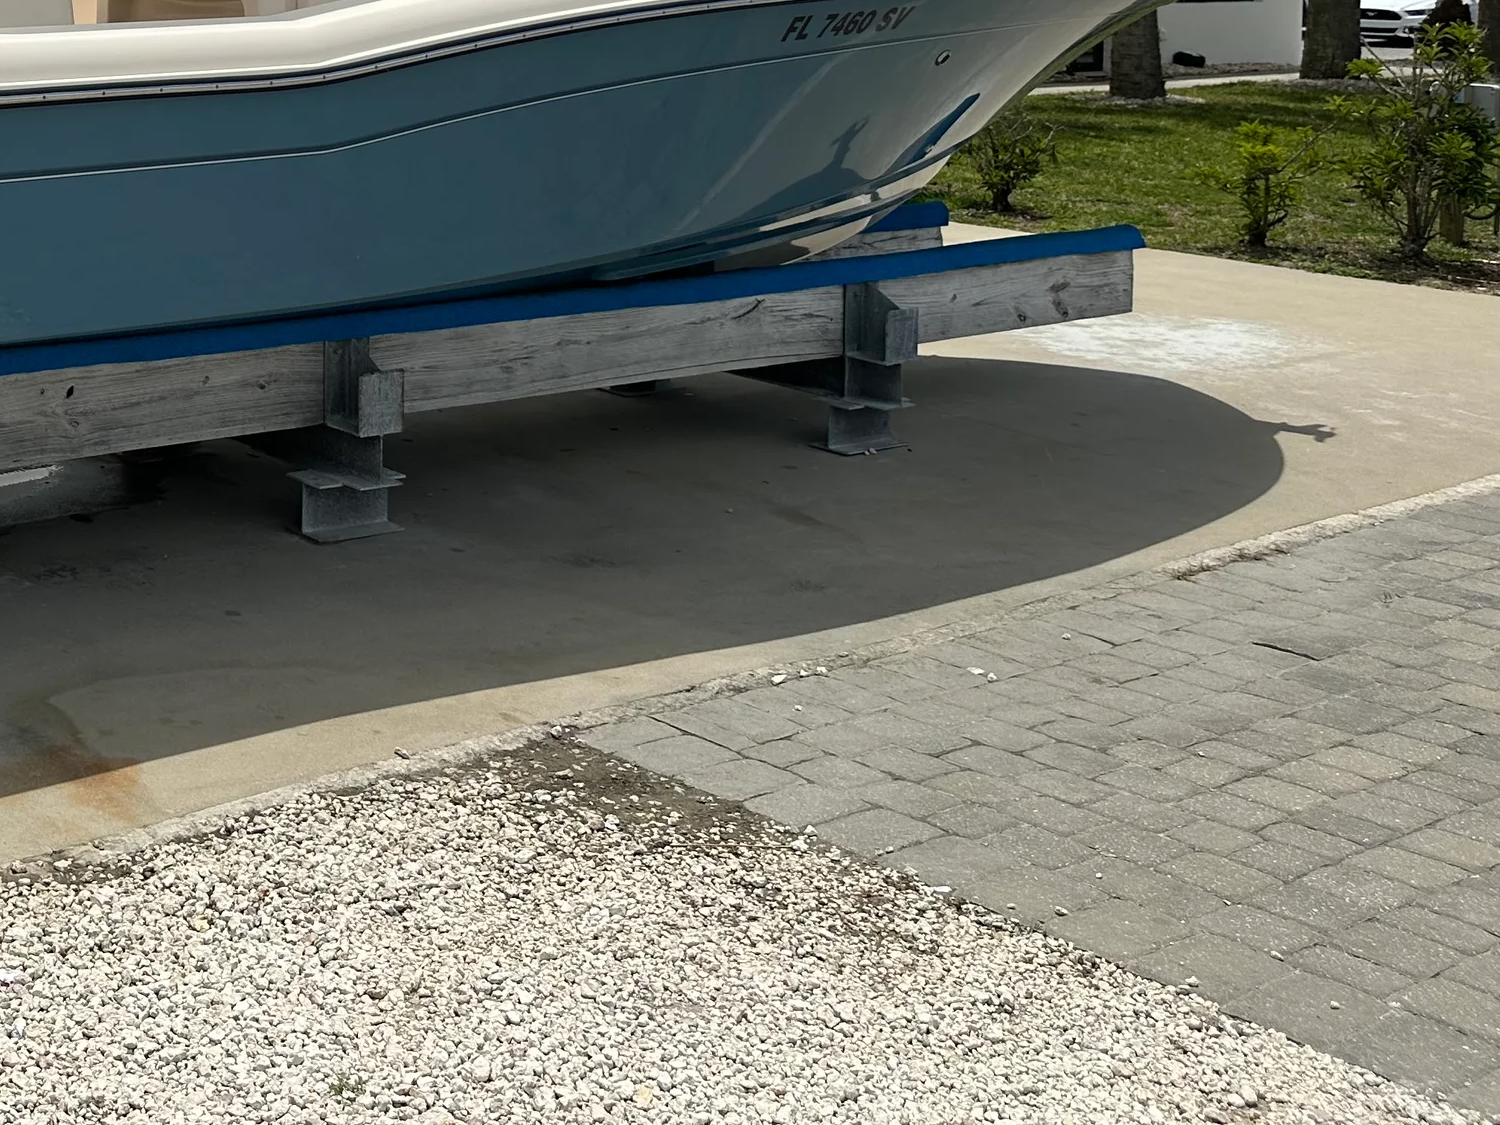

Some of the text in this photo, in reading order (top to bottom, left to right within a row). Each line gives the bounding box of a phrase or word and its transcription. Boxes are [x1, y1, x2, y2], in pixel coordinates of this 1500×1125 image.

[780, 5, 917, 43] FL 7460 SV
